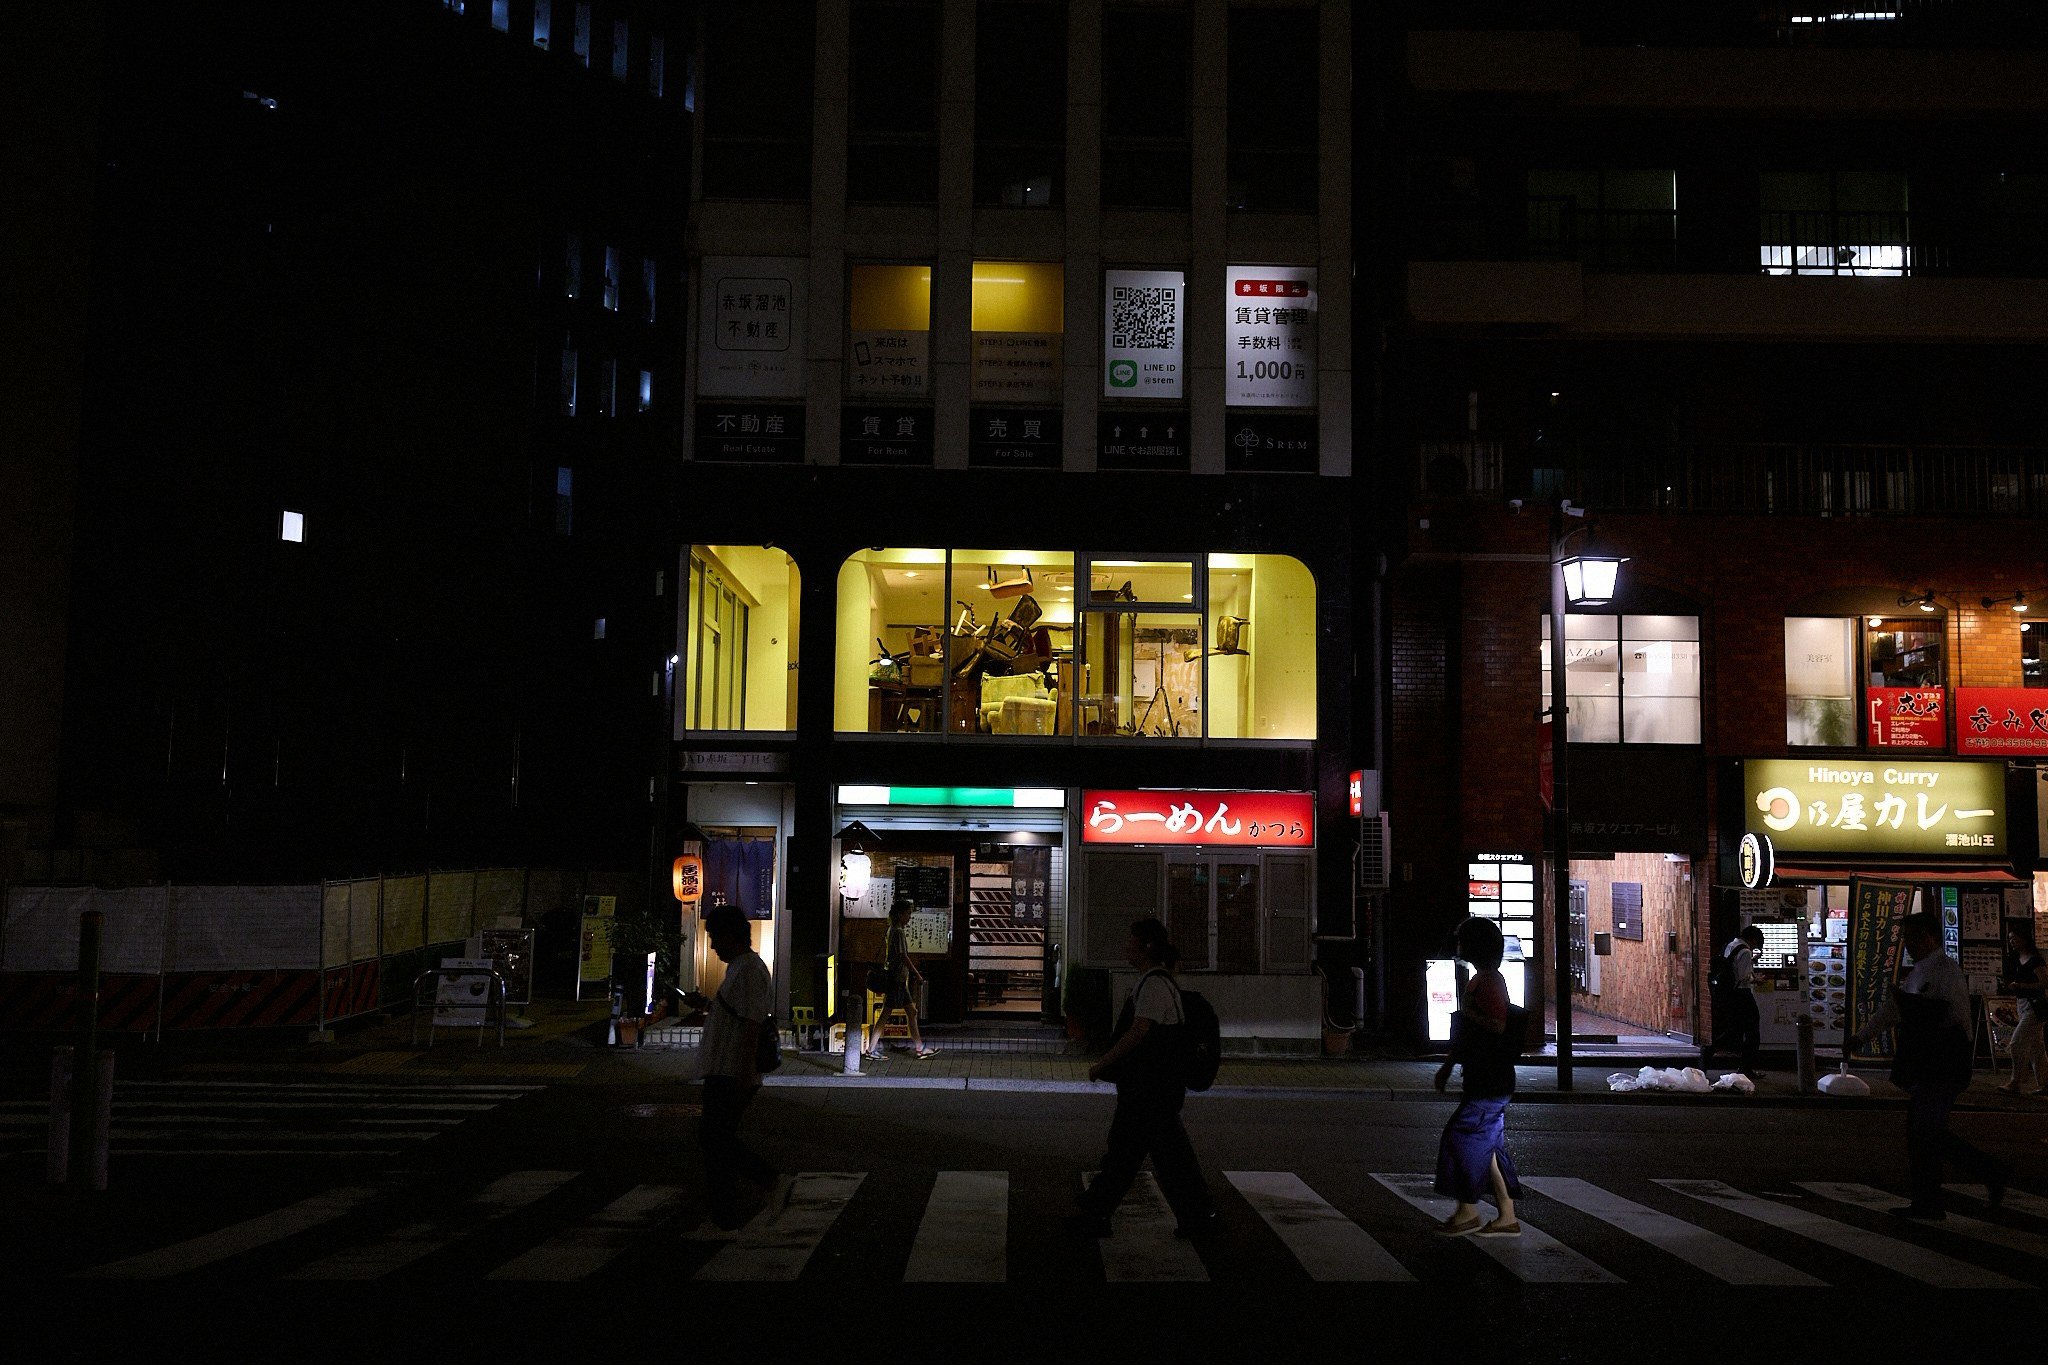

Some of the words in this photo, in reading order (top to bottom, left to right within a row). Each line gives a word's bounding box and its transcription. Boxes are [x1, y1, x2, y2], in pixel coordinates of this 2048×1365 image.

[722, 294, 786, 311] 赤坂溜池
[1234, 307, 1309, 325] 賃貸管理
[728, 320, 779, 338] 不動産
[875, 336, 908, 348] 来店は
[1238, 336, 1281, 350] 手数料
[874, 356, 917, 367] スマホで
[1144, 363, 1164, 372] LINE
[1166, 364, 1176, 372] ID
[1144, 377, 1175, 385] @srem
[716, 414, 785, 433] 不動産
[861, 415, 916, 437] 賃貸
[988, 419, 1042, 439] 売買
[722, 443, 744, 454] Real
[747, 443, 776, 454] Estate
[868, 446, 882, 456] For
[886, 446, 908, 456] Rent
[1266, 440, 1308, 450] SREM
[994, 449, 1010, 458] For
[1013, 449, 1034, 459] Sale
[1808, 767, 1874, 786] Hinoya
[1883, 768, 1939, 787] Curry
[1089, 801, 1241, 835] らーめん
[1249, 821, 1304, 838] かつら
[1569, 822, 1680, 836] 赤坂スクエアービル
[1945, 833, 1995, 847] 溜池山王
[681, 864, 699, 896] 居酒屋
